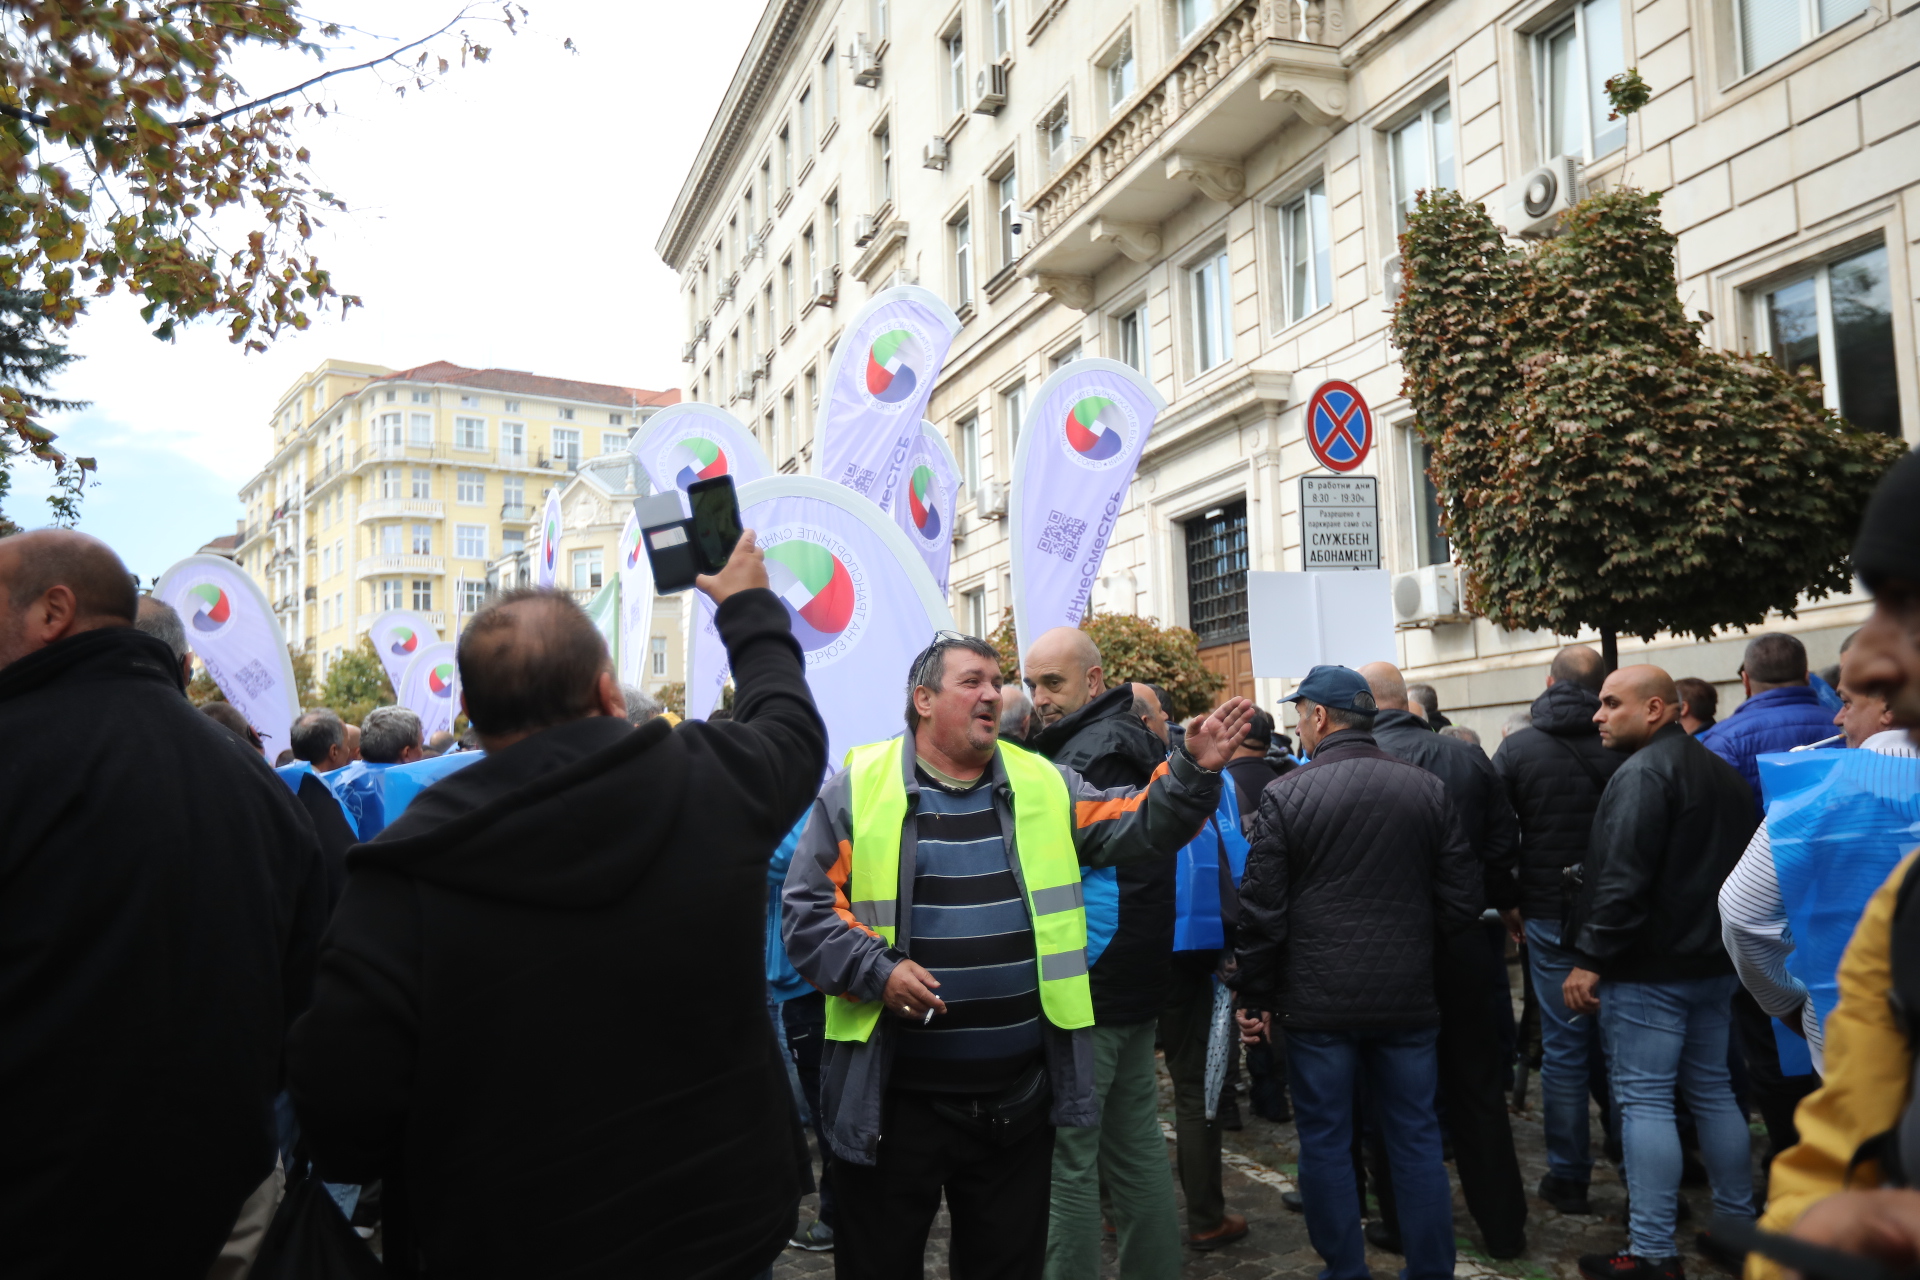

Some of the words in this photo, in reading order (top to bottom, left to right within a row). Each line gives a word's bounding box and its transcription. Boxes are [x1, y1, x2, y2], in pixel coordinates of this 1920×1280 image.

[1076, 456, 1103, 469] СЪЮЗ
[1093, 388, 1136, 421] СИНДИКАТИ
[1308, 481, 1314, 489] В
[1318, 481, 1351, 491] работни
[1319, 510, 1354, 519] Разрешено
[1308, 520, 1341, 529] паркиране
[1312, 533, 1369, 546] СЛУЖЕБЕН
[1065, 490, 1122, 623] #НиеСмеСТСБ
[1310, 549, 1374, 562] АБОНАМЕНТ
